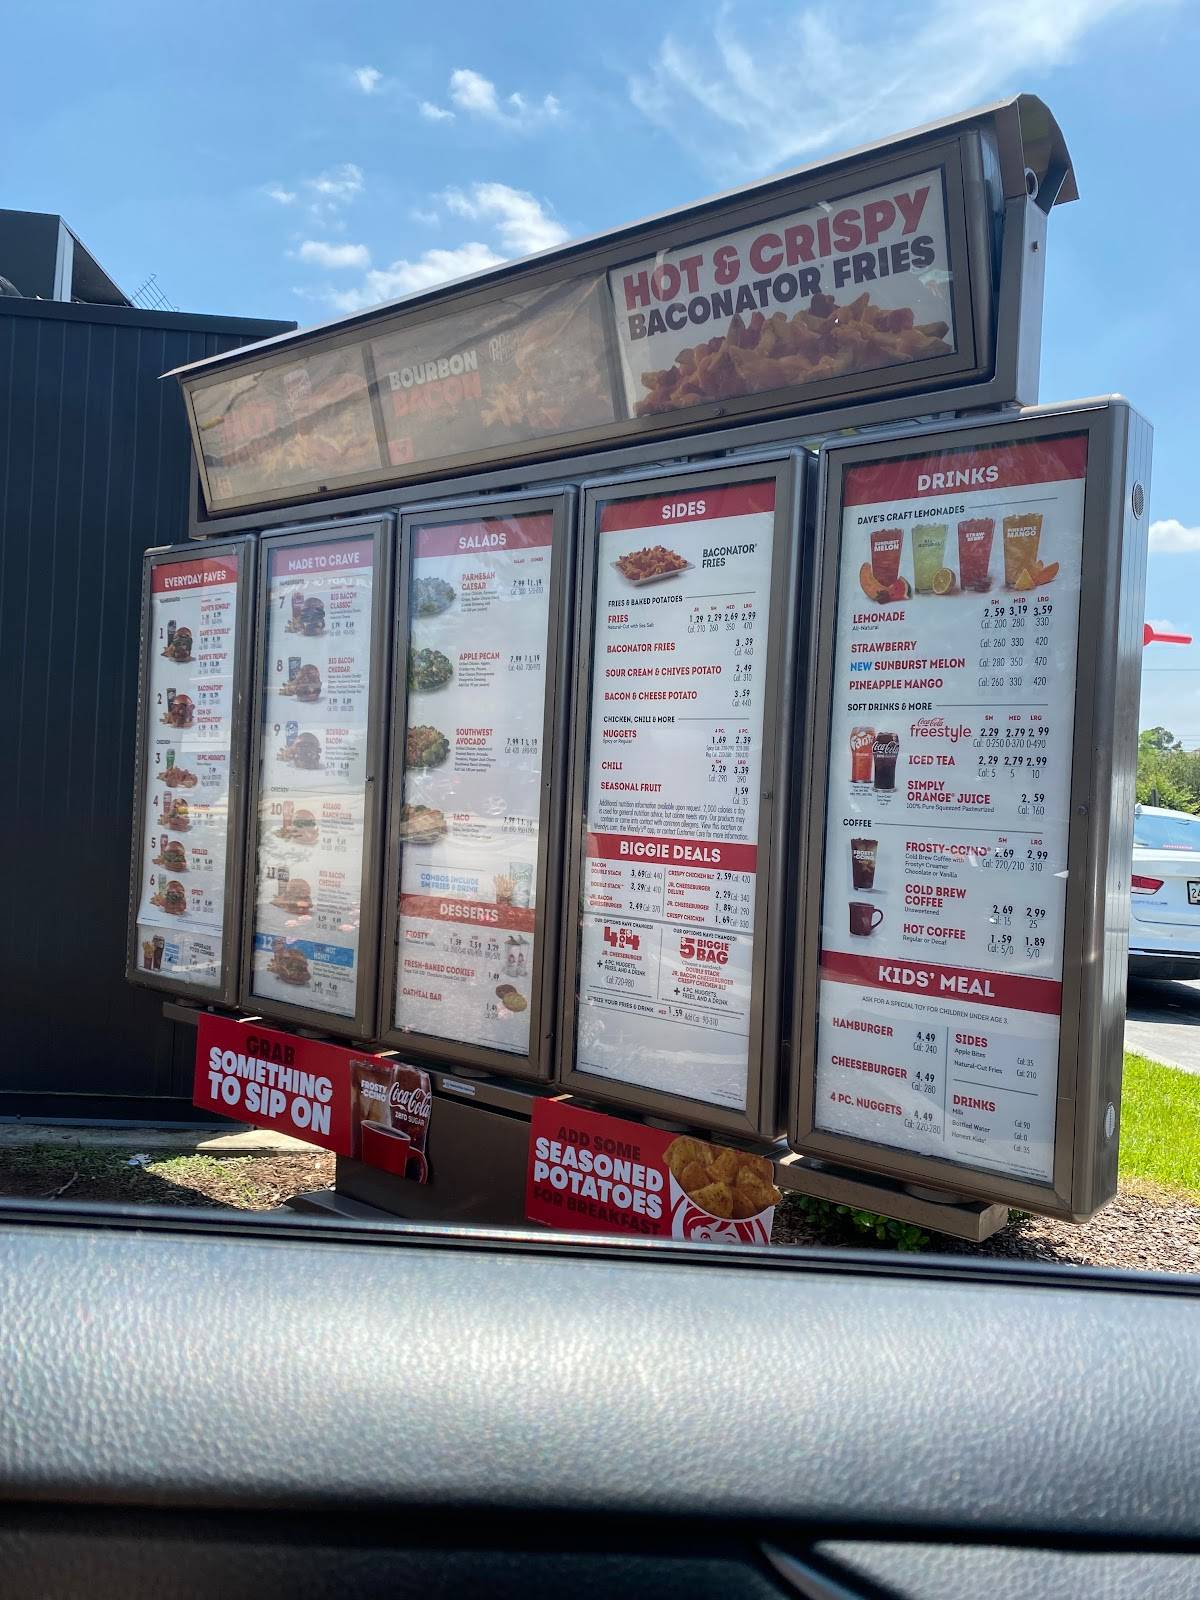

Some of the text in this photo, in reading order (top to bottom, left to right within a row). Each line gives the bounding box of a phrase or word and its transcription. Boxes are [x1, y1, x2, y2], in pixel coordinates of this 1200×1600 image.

[623, 186, 931, 311] HOT & CRISPY
[628, 235, 936, 341] BACONATOR FRIES
[388, 350, 478, 391] BOURBON
[917, 465, 999, 491] DRINKS
[662, 500, 706, 519] SIDES
[857, 506, 965, 524] DAVE'S CRAFT LEMONADES
[459, 533, 507, 549] SALADS
[702, 544, 755, 558] BACONATOR
[288, 552, 359, 570] MADE TO CRAVE
[702, 558, 726, 568] FRIES
[164, 570, 226, 588] EVERYDAY FAVES
[279, 596, 285, 608] 7
[608, 597, 625, 607] FRIES
[630, 598, 650, 606] BAKED
[652, 595, 683, 605] POTATOES
[708, 612, 756, 622] 2.29 2.69 2.99
[984, 605, 1053, 617] 2.59 3.19 3.59
[608, 615, 629, 624] FRIES
[853, 611, 905, 624] LEMONADE
[994, 617, 1049, 628] 200 280 330
[159, 628, 163, 639] 1
[607, 643, 675, 653] BACONATOR FRIES
[736, 638, 753, 647] 3.39
[851, 641, 917, 653] STRAWBERRY
[277, 659, 283, 672] 8
[736, 665, 752, 673] 2.49
[850, 658, 965, 672] NEW SUNBURST MELON
[605, 666, 722, 678] SOUR CREAM & CHIVES POTATO
[849, 679, 943, 690] PINEAPPLE MANGO
[157, 693, 162, 704] 2
[605, 691, 697, 700] BACON & CHEESE POTATO
[734, 690, 750, 698] 3.59
[848, 703, 866, 711] SOFT
[273, 724, 281, 736] 9
[456, 728, 493, 736] SOUTHWEST
[603, 730, 637, 738] NUGGETS
[910, 724, 972, 742] freestyle
[981, 727, 1049, 737] 2.29 2.79 2.99
[736, 736, 751, 744] 2.39
[908, 755, 955, 766] ICED TEA
[979, 756, 1047, 766] 2.29 2.79 2.99
[601, 782, 662, 792] SEASONAL FRUIT
[908, 780, 945, 791] SIMPLY
[907, 792, 991, 804] ORANGE JUICE
[1022, 794, 1044, 803] 2.59
[843, 819, 872, 828] COFFEE
[620, 841, 721, 862] BIGGIE DEALS
[906, 842, 988, 856] FROSTY-CCINO
[1027, 850, 1048, 860] 2.99
[905, 884, 966, 898] COLD BREW
[905, 896, 943, 907] COFFEE
[440, 903, 498, 921] DESSERTS
[993, 905, 1045, 918] 2.69 2.99
[903, 924, 965, 939] HOT COFFEE
[698, 939, 729, 950] BIGGIE
[991, 935, 1045, 946] 1.59 1.89
[696, 948, 728, 964] BAG
[404, 959, 444, 973] FRESH-BAKED
[446, 966, 475, 977] COOKIES
[878, 966, 995, 997] KIDS' MEAL
[430, 992, 442, 1001] BAR
[832, 1018, 893, 1037] HAMBURGER
[917, 1032, 936, 1042] 4.49
[955, 1034, 988, 1048] SIDES
[246, 1035, 296, 1065] GRAB
[832, 1056, 907, 1079] CHEESEBURGER
[209, 1047, 333, 1102] SOMETHING
[916, 1071, 935, 1083] 4.49
[361, 1080, 388, 1093] FROSTY
[208, 1070, 331, 1135] TO SIP ON
[389, 1082, 431, 1117] Coca-Cola
[830, 1092, 902, 1116] 4 PC. NUGGETS
[953, 1095, 996, 1112] DRINKS
[408, 1116, 424, 1126] SUGAR
[914, 1110, 933, 1121] 4.49
[558, 1126, 640, 1160] ADD SOME
[535, 1137, 663, 1191] SEASONED
[534, 1160, 662, 1219] POTATOES
[534, 1185, 661, 1234] FOR BREAKFAST
